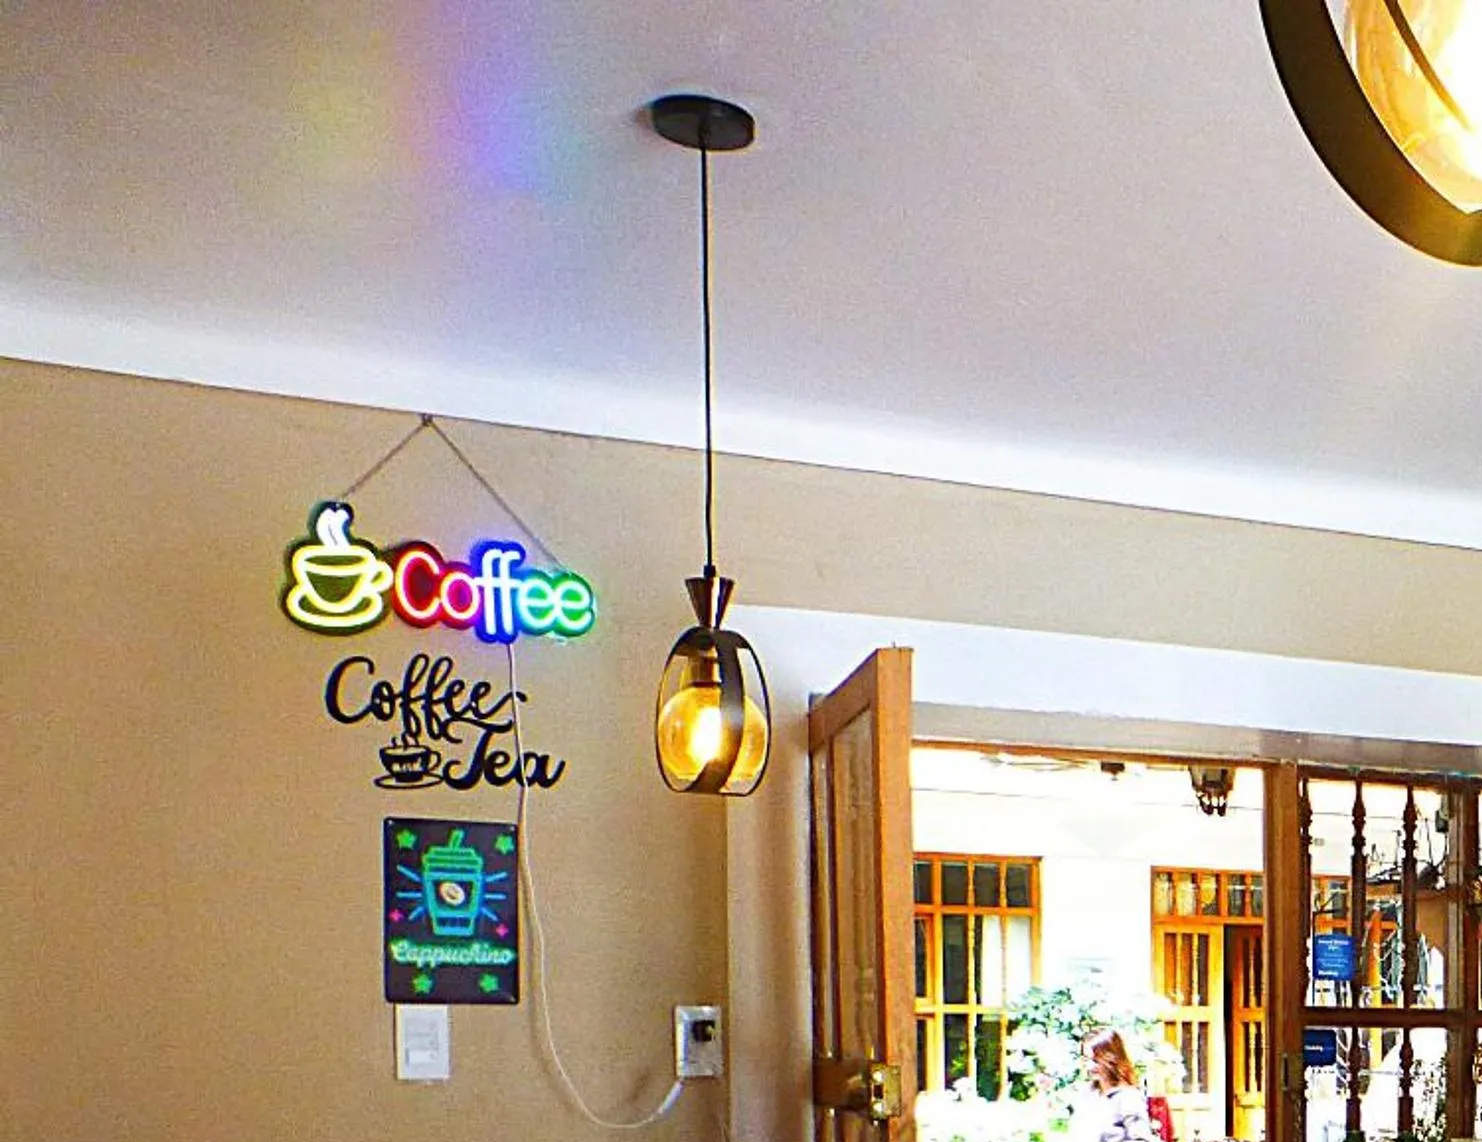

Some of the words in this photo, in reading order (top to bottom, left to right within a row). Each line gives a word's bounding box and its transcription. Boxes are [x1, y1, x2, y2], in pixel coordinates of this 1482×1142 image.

[394, 548, 594, 636] Coffee
[324, 653, 528, 741] Coffee
[441, 716, 567, 790] Tea
